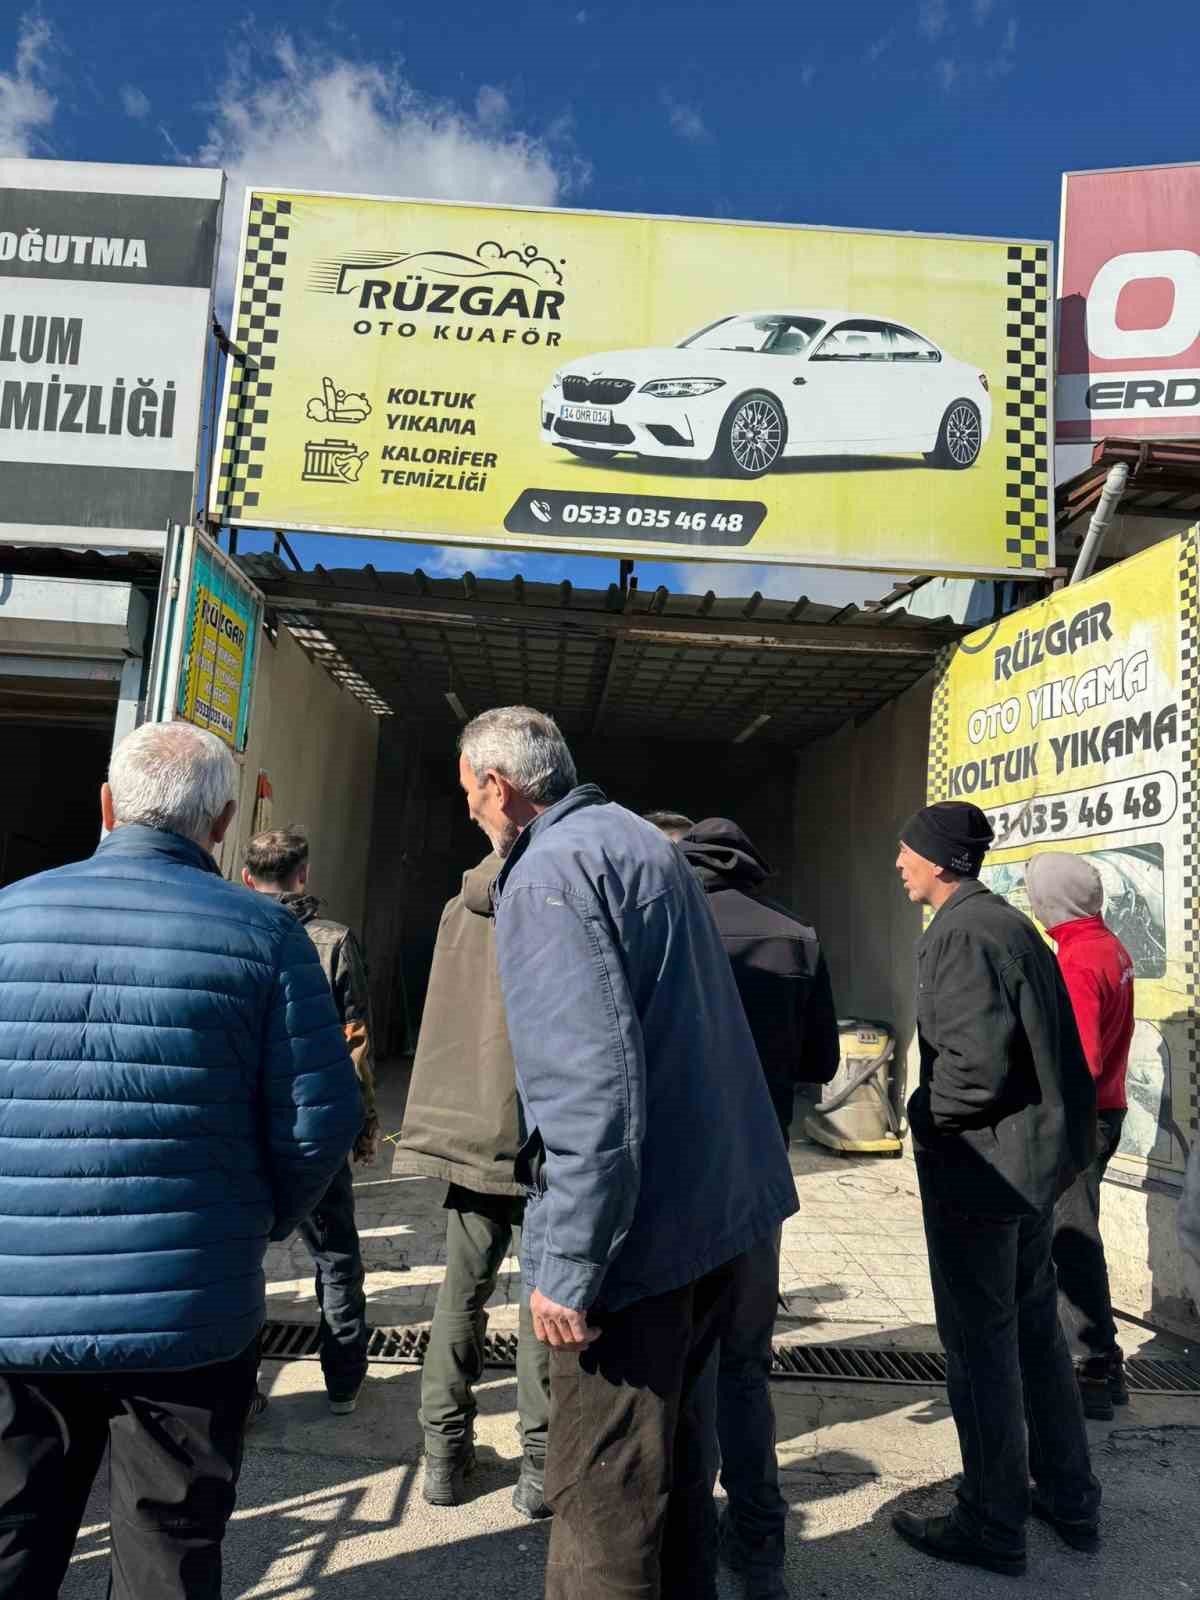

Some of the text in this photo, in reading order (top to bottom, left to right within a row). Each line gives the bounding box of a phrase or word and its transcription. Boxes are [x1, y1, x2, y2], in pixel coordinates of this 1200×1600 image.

[0, 227, 148, 268] OĞUTMA
[358, 275, 565, 320] RÜZGAR
[0, 314, 83, 365] LUM
[353, 320, 562, 347] OTO KUAFÖR
[0, 374, 177, 439] MİZLİĞİ
[387, 388, 477, 409] KOLTUK
[386, 413, 476, 436] YIKAMA
[381, 445, 498, 468] KALORİFER
[381, 468, 487, 492] TEMİZLİĞİ
[562, 504, 744, 532] 0533 035 46 48
[994, 601, 1113, 681] RÜZGAR
[967, 649, 1149, 744] OTO YIKAMA
[948, 703, 1178, 798] KOLTUK YIKAMA
[1019, 801, 1069, 838] 035
[1078, 792, 1113, 828] 46
[1123, 781, 1162, 820] 48
